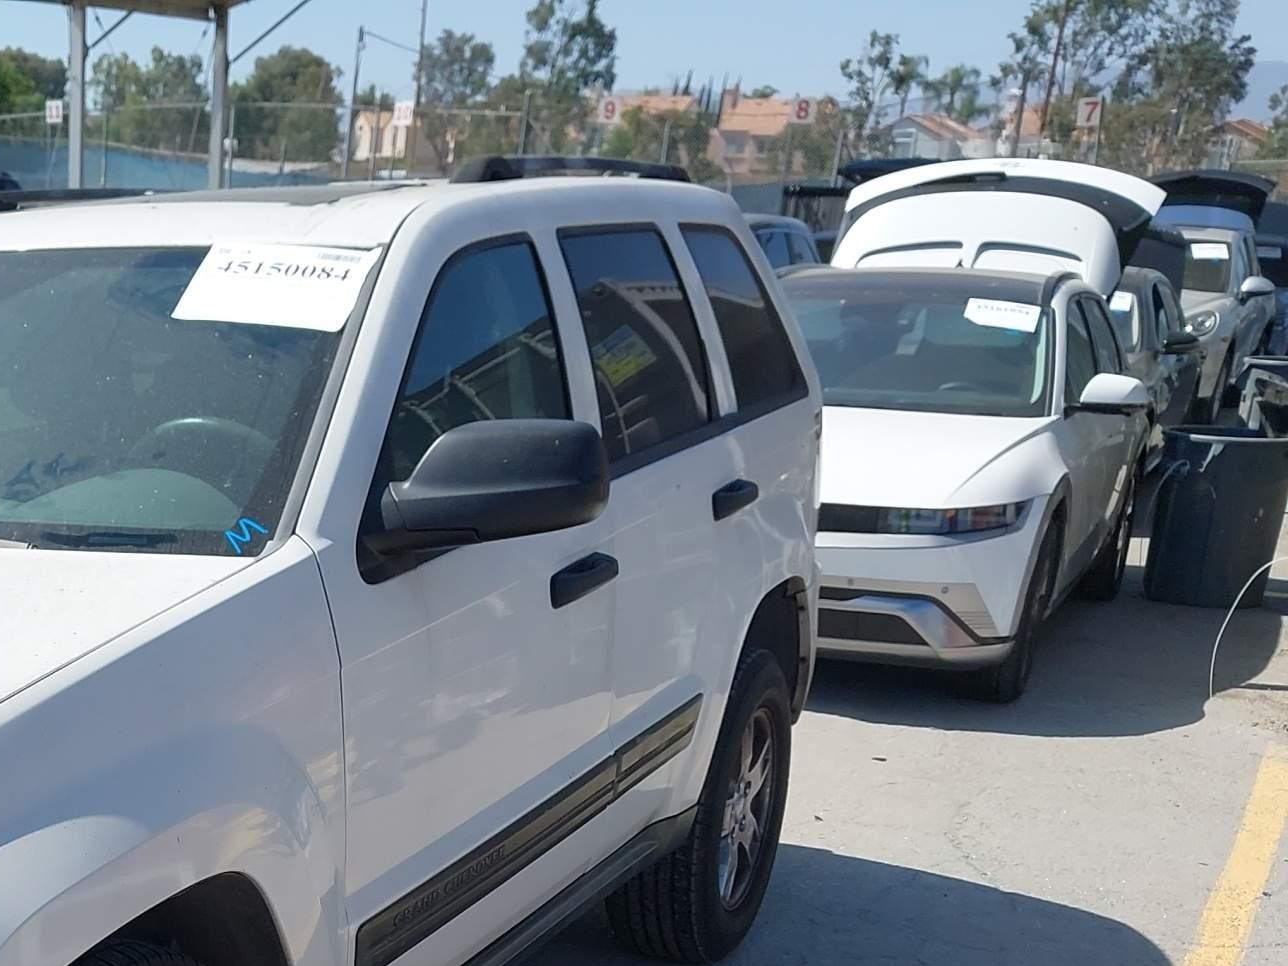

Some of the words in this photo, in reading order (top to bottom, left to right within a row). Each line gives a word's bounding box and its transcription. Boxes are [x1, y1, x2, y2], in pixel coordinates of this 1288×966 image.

[603, 100, 617, 120] 9
[795, 99, 811, 120] 8
[1085, 101, 1100, 123] 7
[216, 259, 351, 281] 45150084
